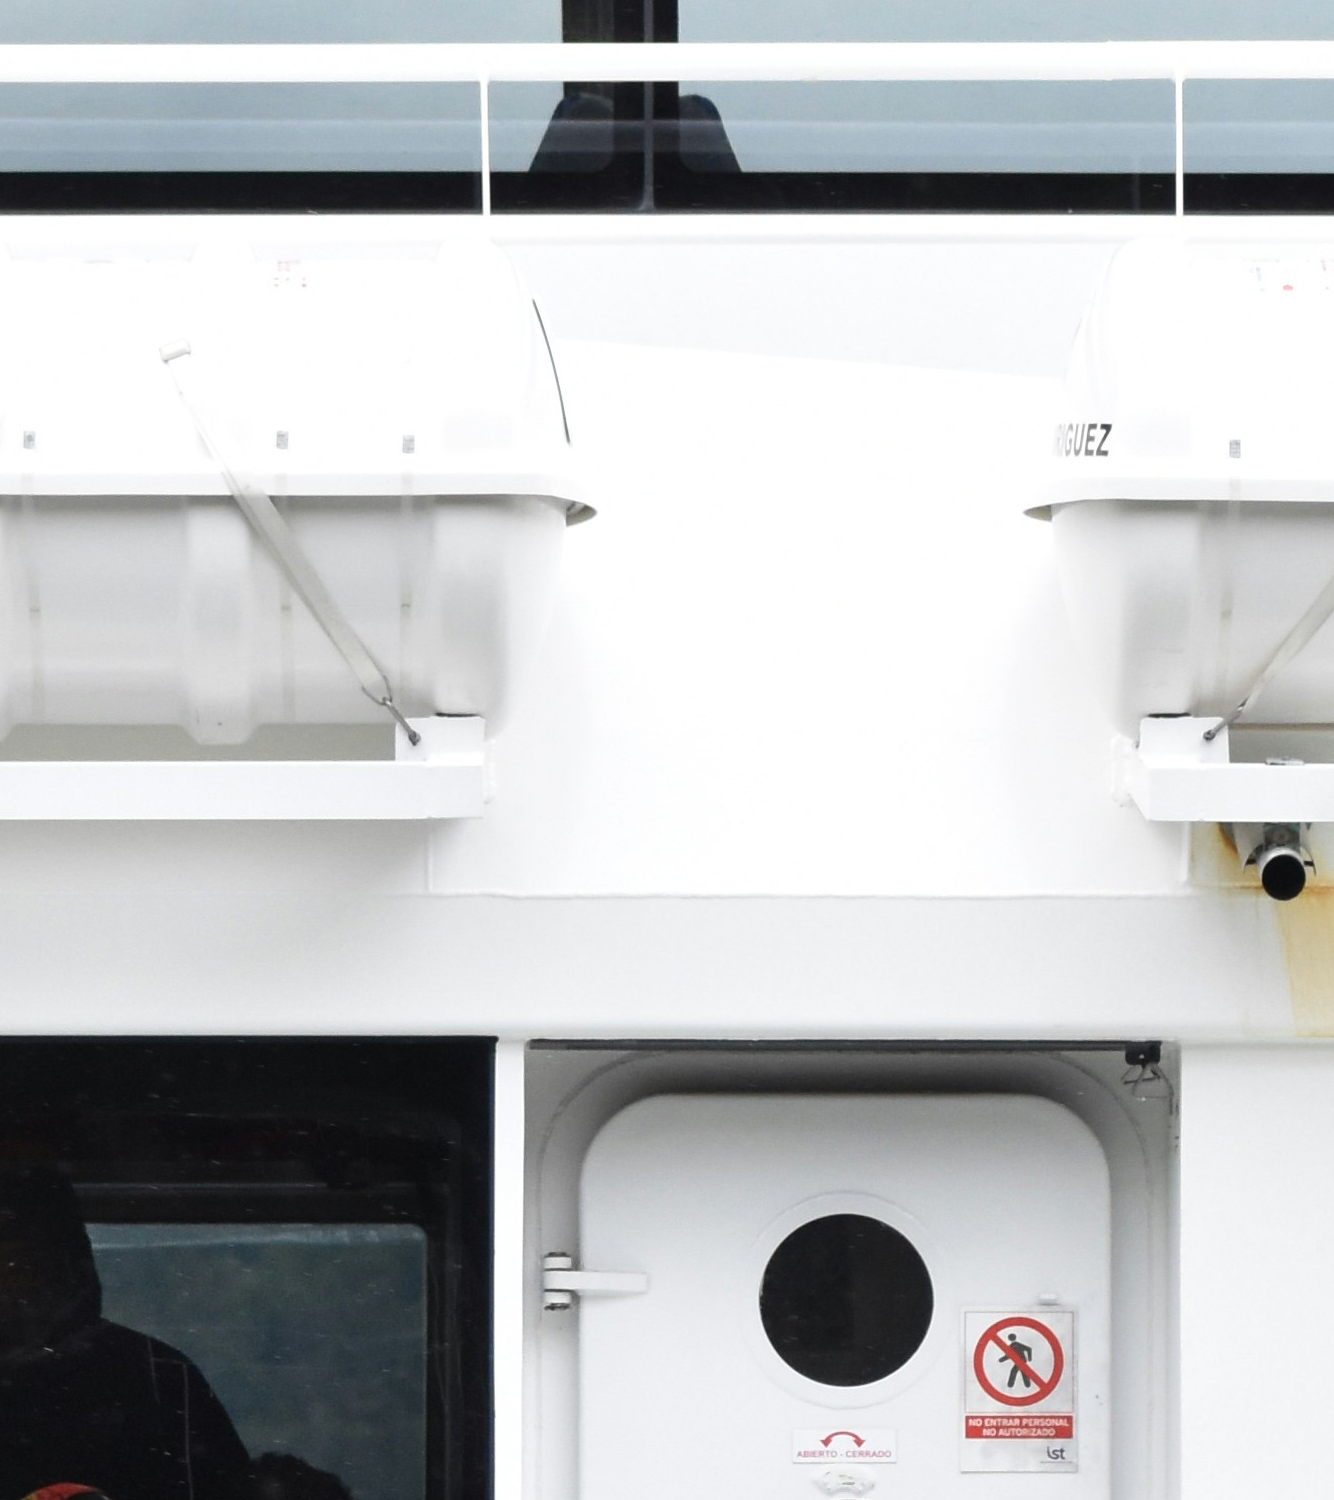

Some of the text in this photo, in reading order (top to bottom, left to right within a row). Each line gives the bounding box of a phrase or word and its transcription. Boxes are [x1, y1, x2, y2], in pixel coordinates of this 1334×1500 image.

[968, 1418, 1069, 1427] NO ENTRAR PERSONAL
[982, 1428, 1056, 1437] NO AUTORIZADO
[797, 1450, 838, 1458] ABIERTO
[845, 1450, 892, 1458] CERRADO
